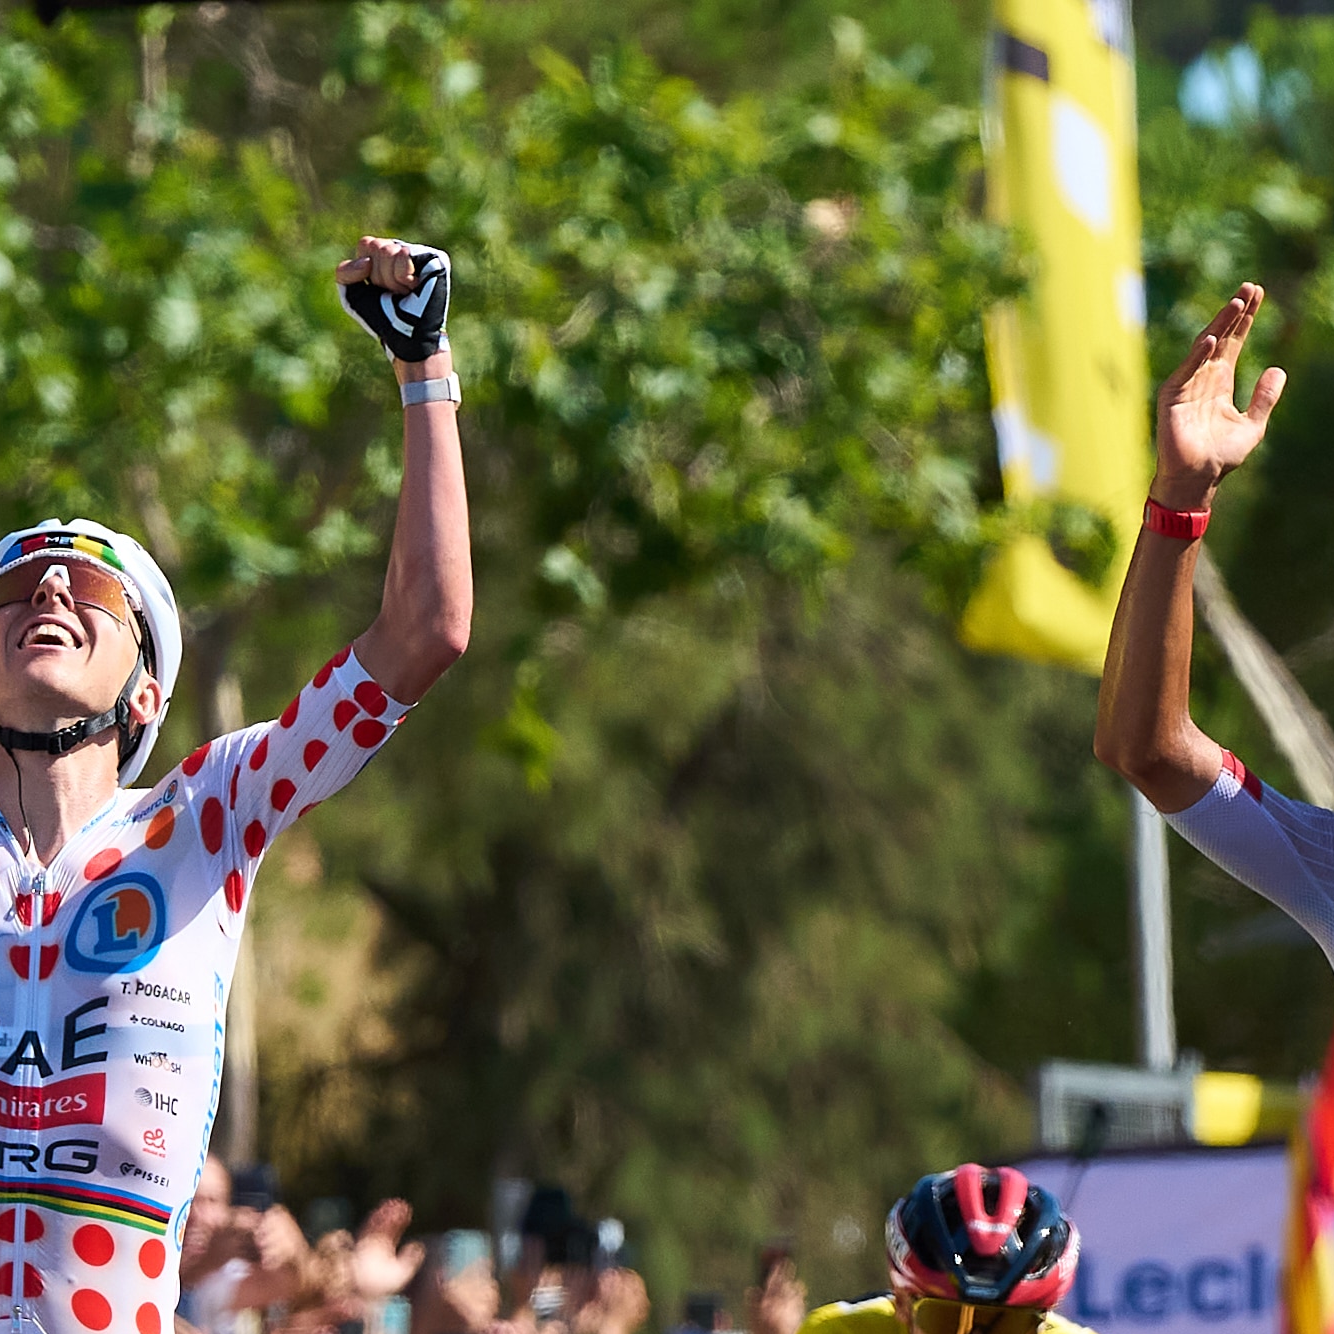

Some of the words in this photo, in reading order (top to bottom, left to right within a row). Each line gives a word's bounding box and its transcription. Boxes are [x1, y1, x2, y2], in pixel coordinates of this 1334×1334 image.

[121, 981, 131, 995] T.
[136, 981, 191, 1005] POGACAR
[141, 1016, 185, 1033] COLNAGO
[155, 1092, 179, 1116] IHC
[133, 1166, 170, 1188] PISSEI
